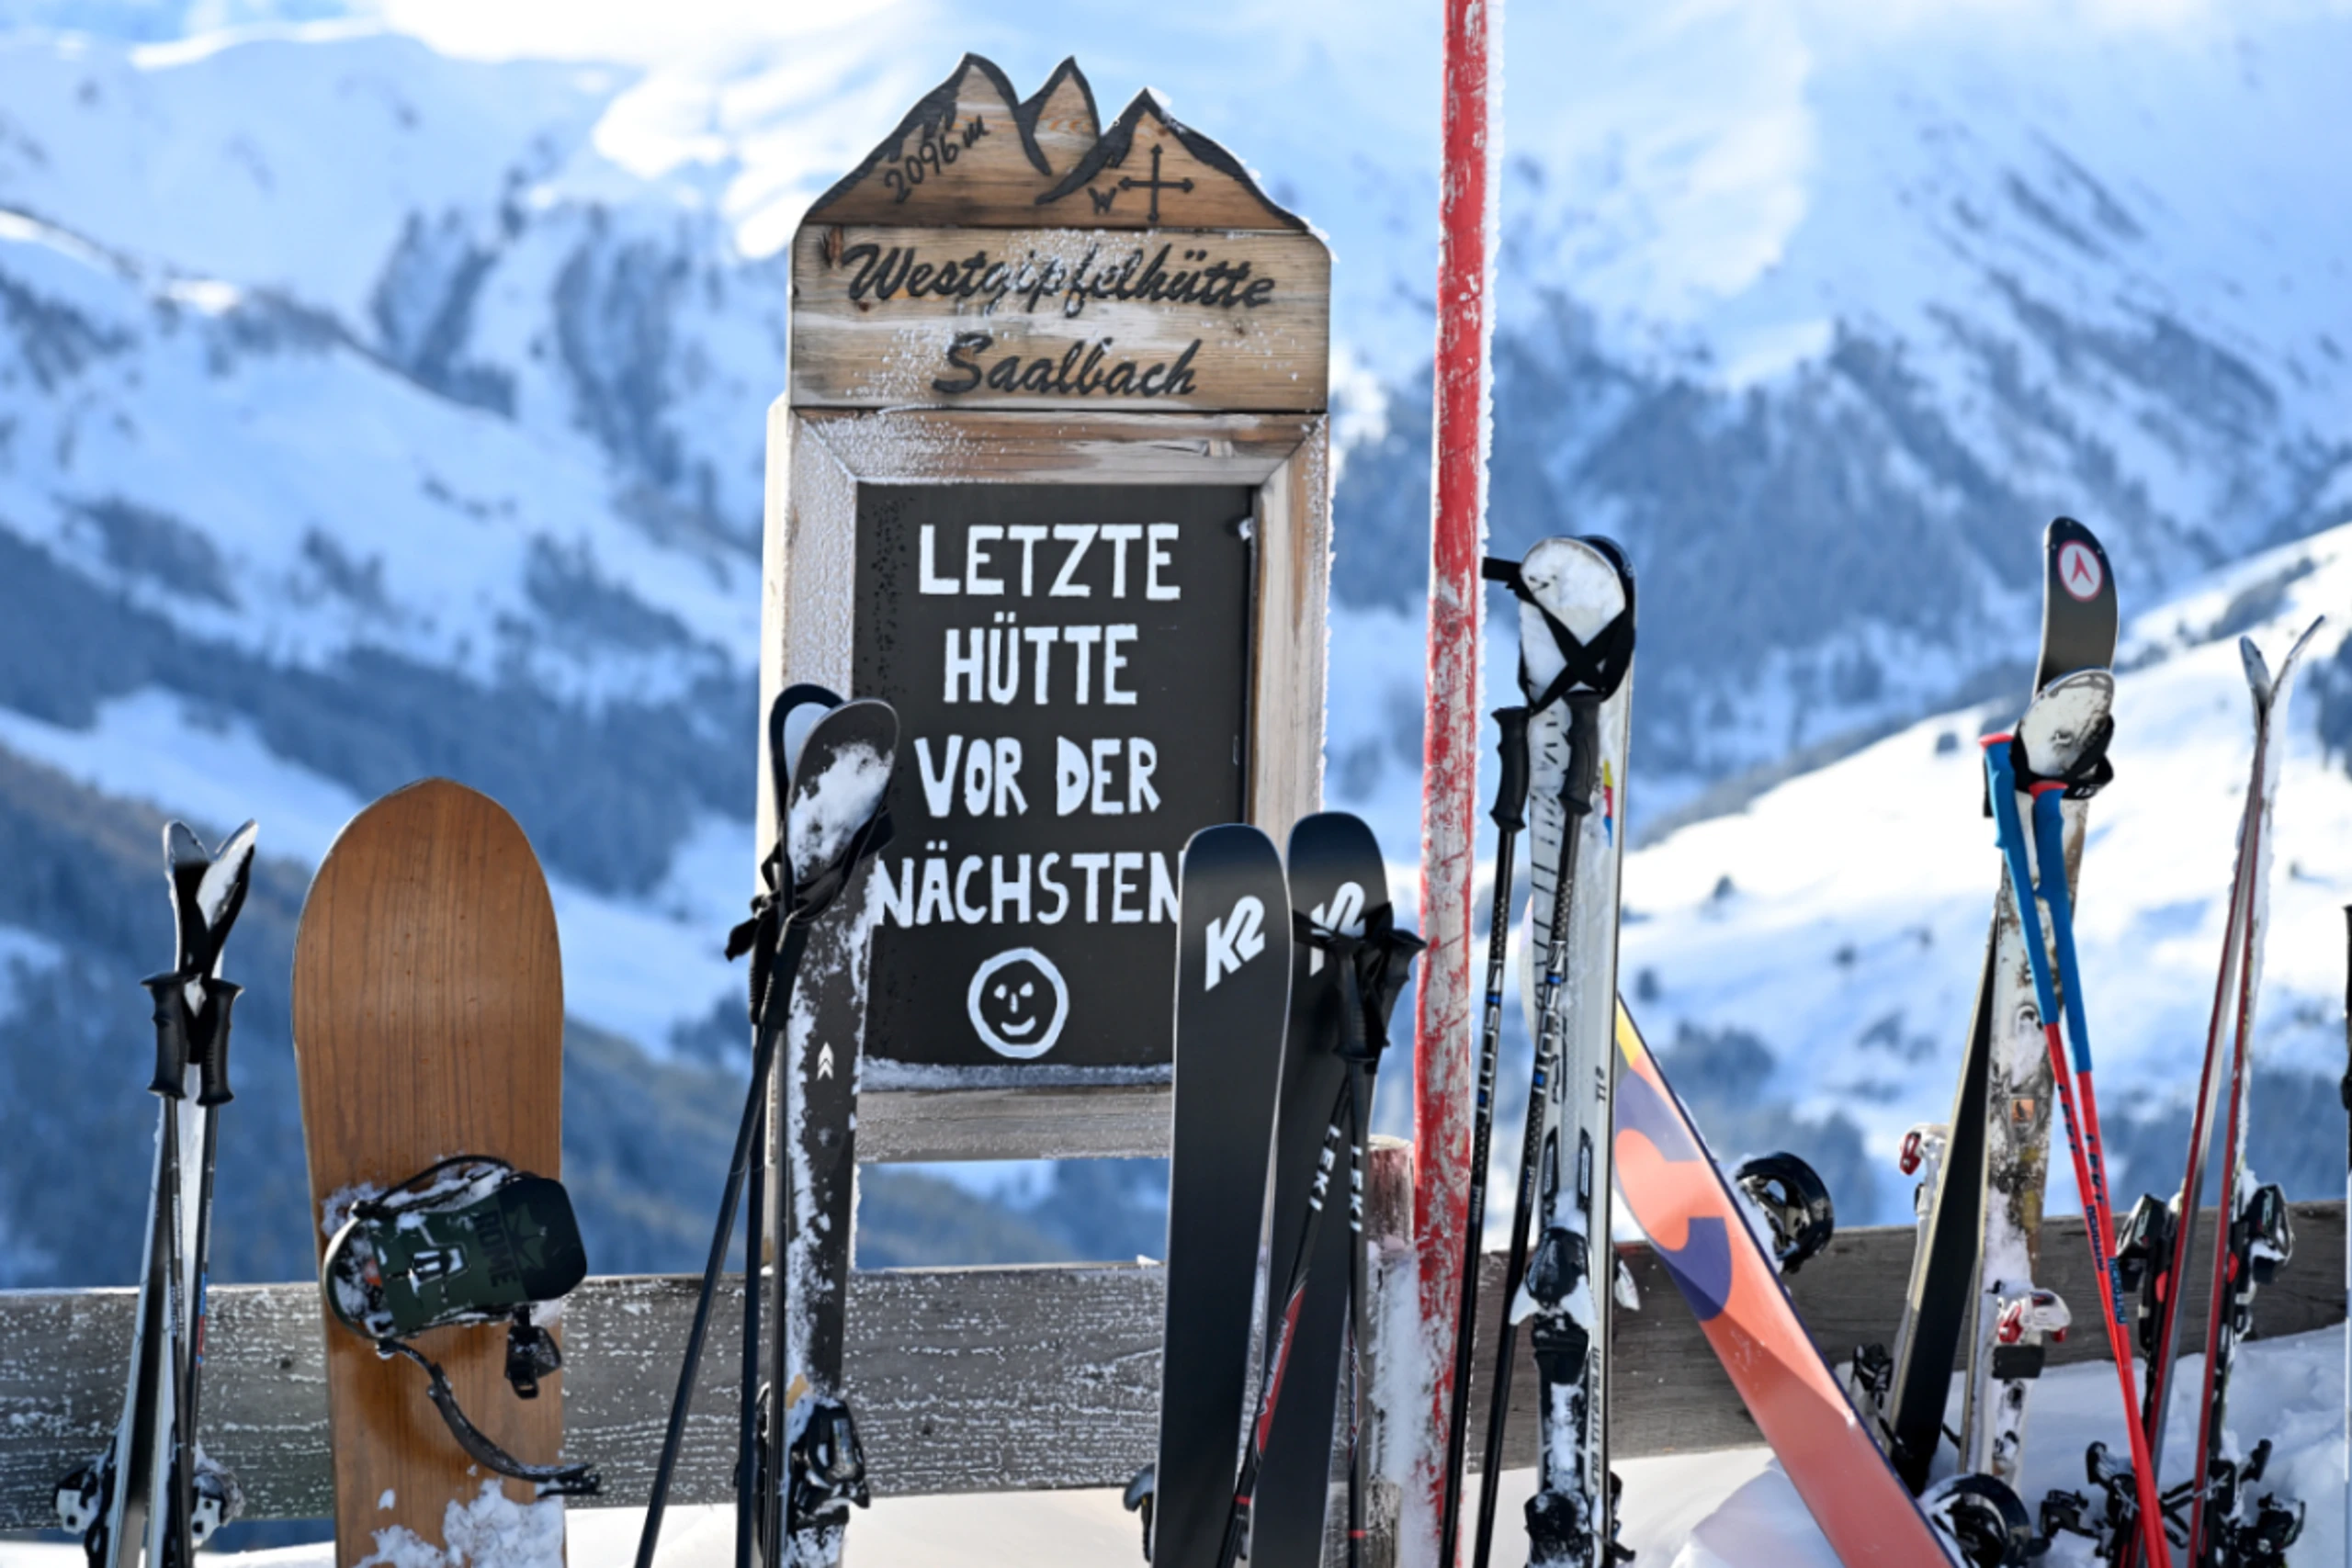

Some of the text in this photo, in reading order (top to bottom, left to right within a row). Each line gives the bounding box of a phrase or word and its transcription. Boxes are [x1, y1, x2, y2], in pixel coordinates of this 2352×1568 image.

[883, 131, 959, 205] 2096
[842, 243, 1275, 318] Westgipfelhütte
[933, 332, 1203, 396] Saalbach
[919, 523, 1182, 600] LETZTE
[944, 611, 1138, 705] HÜTTE
[913, 734, 1161, 818] VOR DER
[875, 840, 1183, 928] NÄCHSTEN
[1204, 896, 1265, 992] K2
[1308, 1124, 1341, 1212] LEKI
[1349, 1144, 1363, 1233] LEKI
[474, 1210, 519, 1288] ROME
